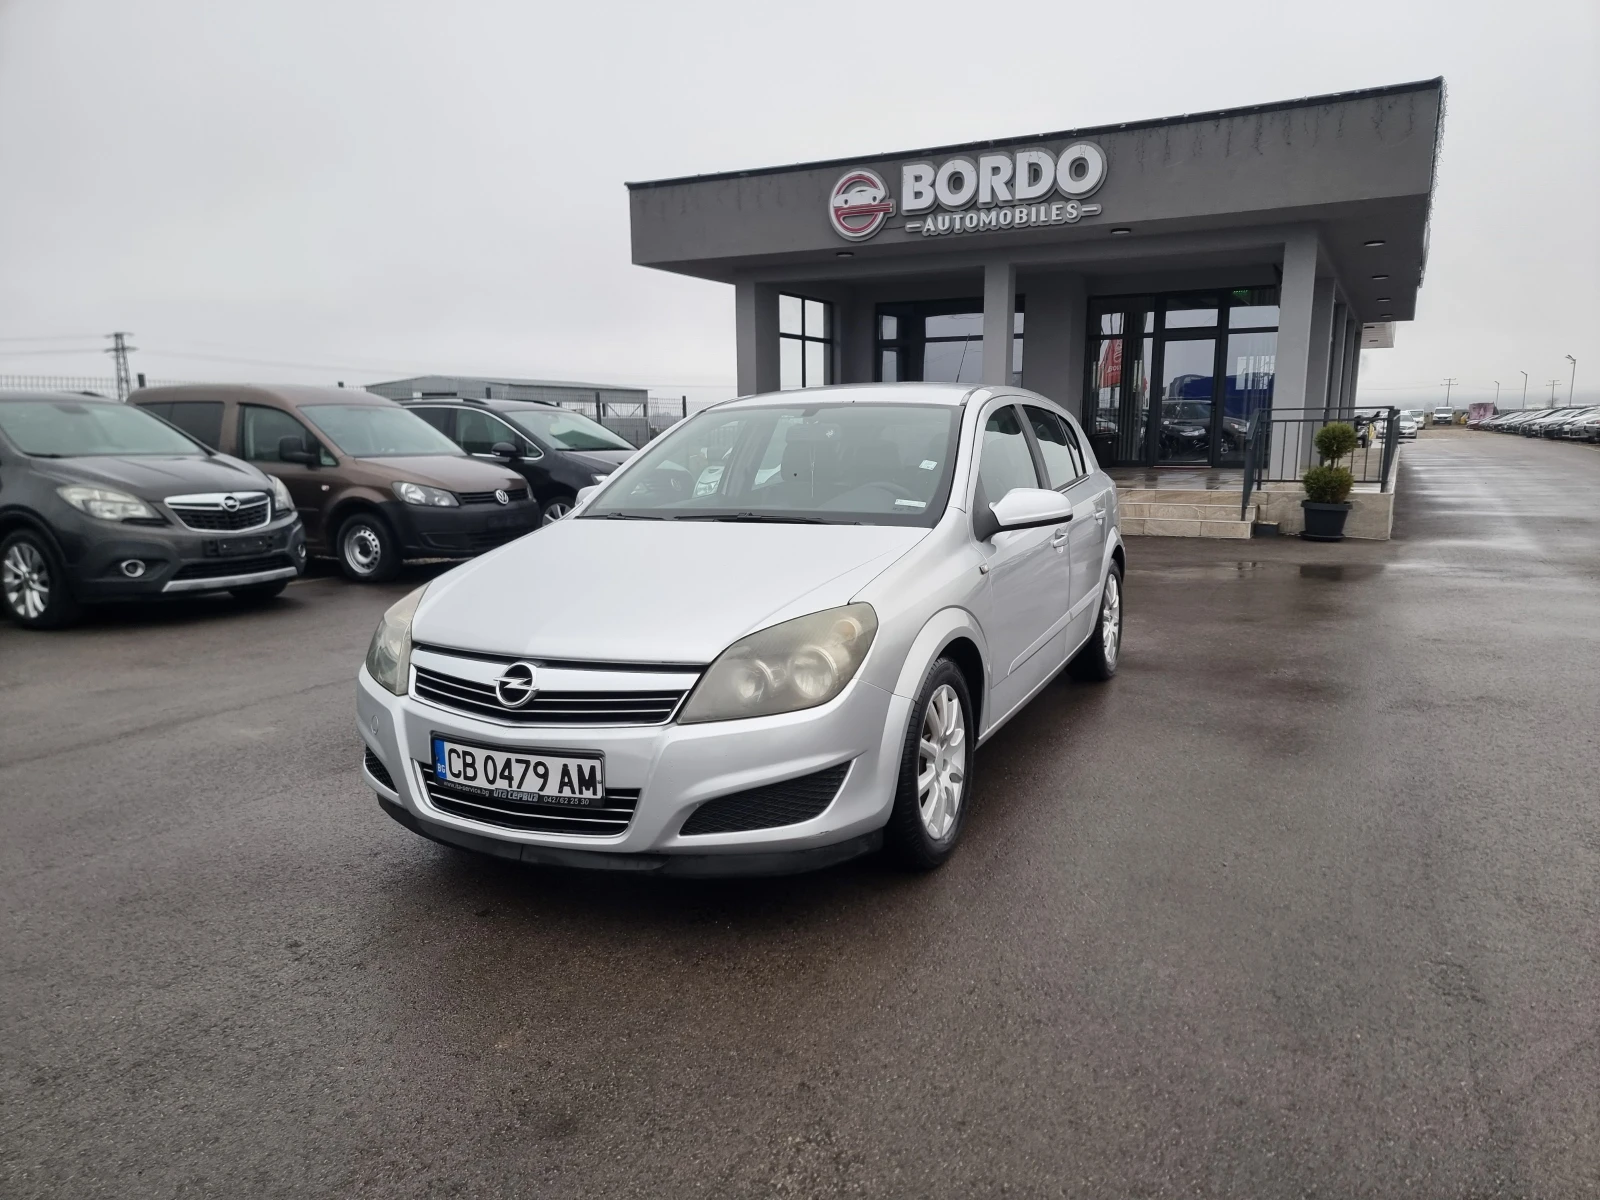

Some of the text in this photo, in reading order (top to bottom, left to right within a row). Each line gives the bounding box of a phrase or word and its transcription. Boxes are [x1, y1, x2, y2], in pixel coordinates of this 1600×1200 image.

[902, 144, 1103, 211] BORDO
[923, 203, 1079, 232] AUTOMOBILES
[437, 763, 446, 773] BG
[448, 747, 598, 796] CB 0479 AM
